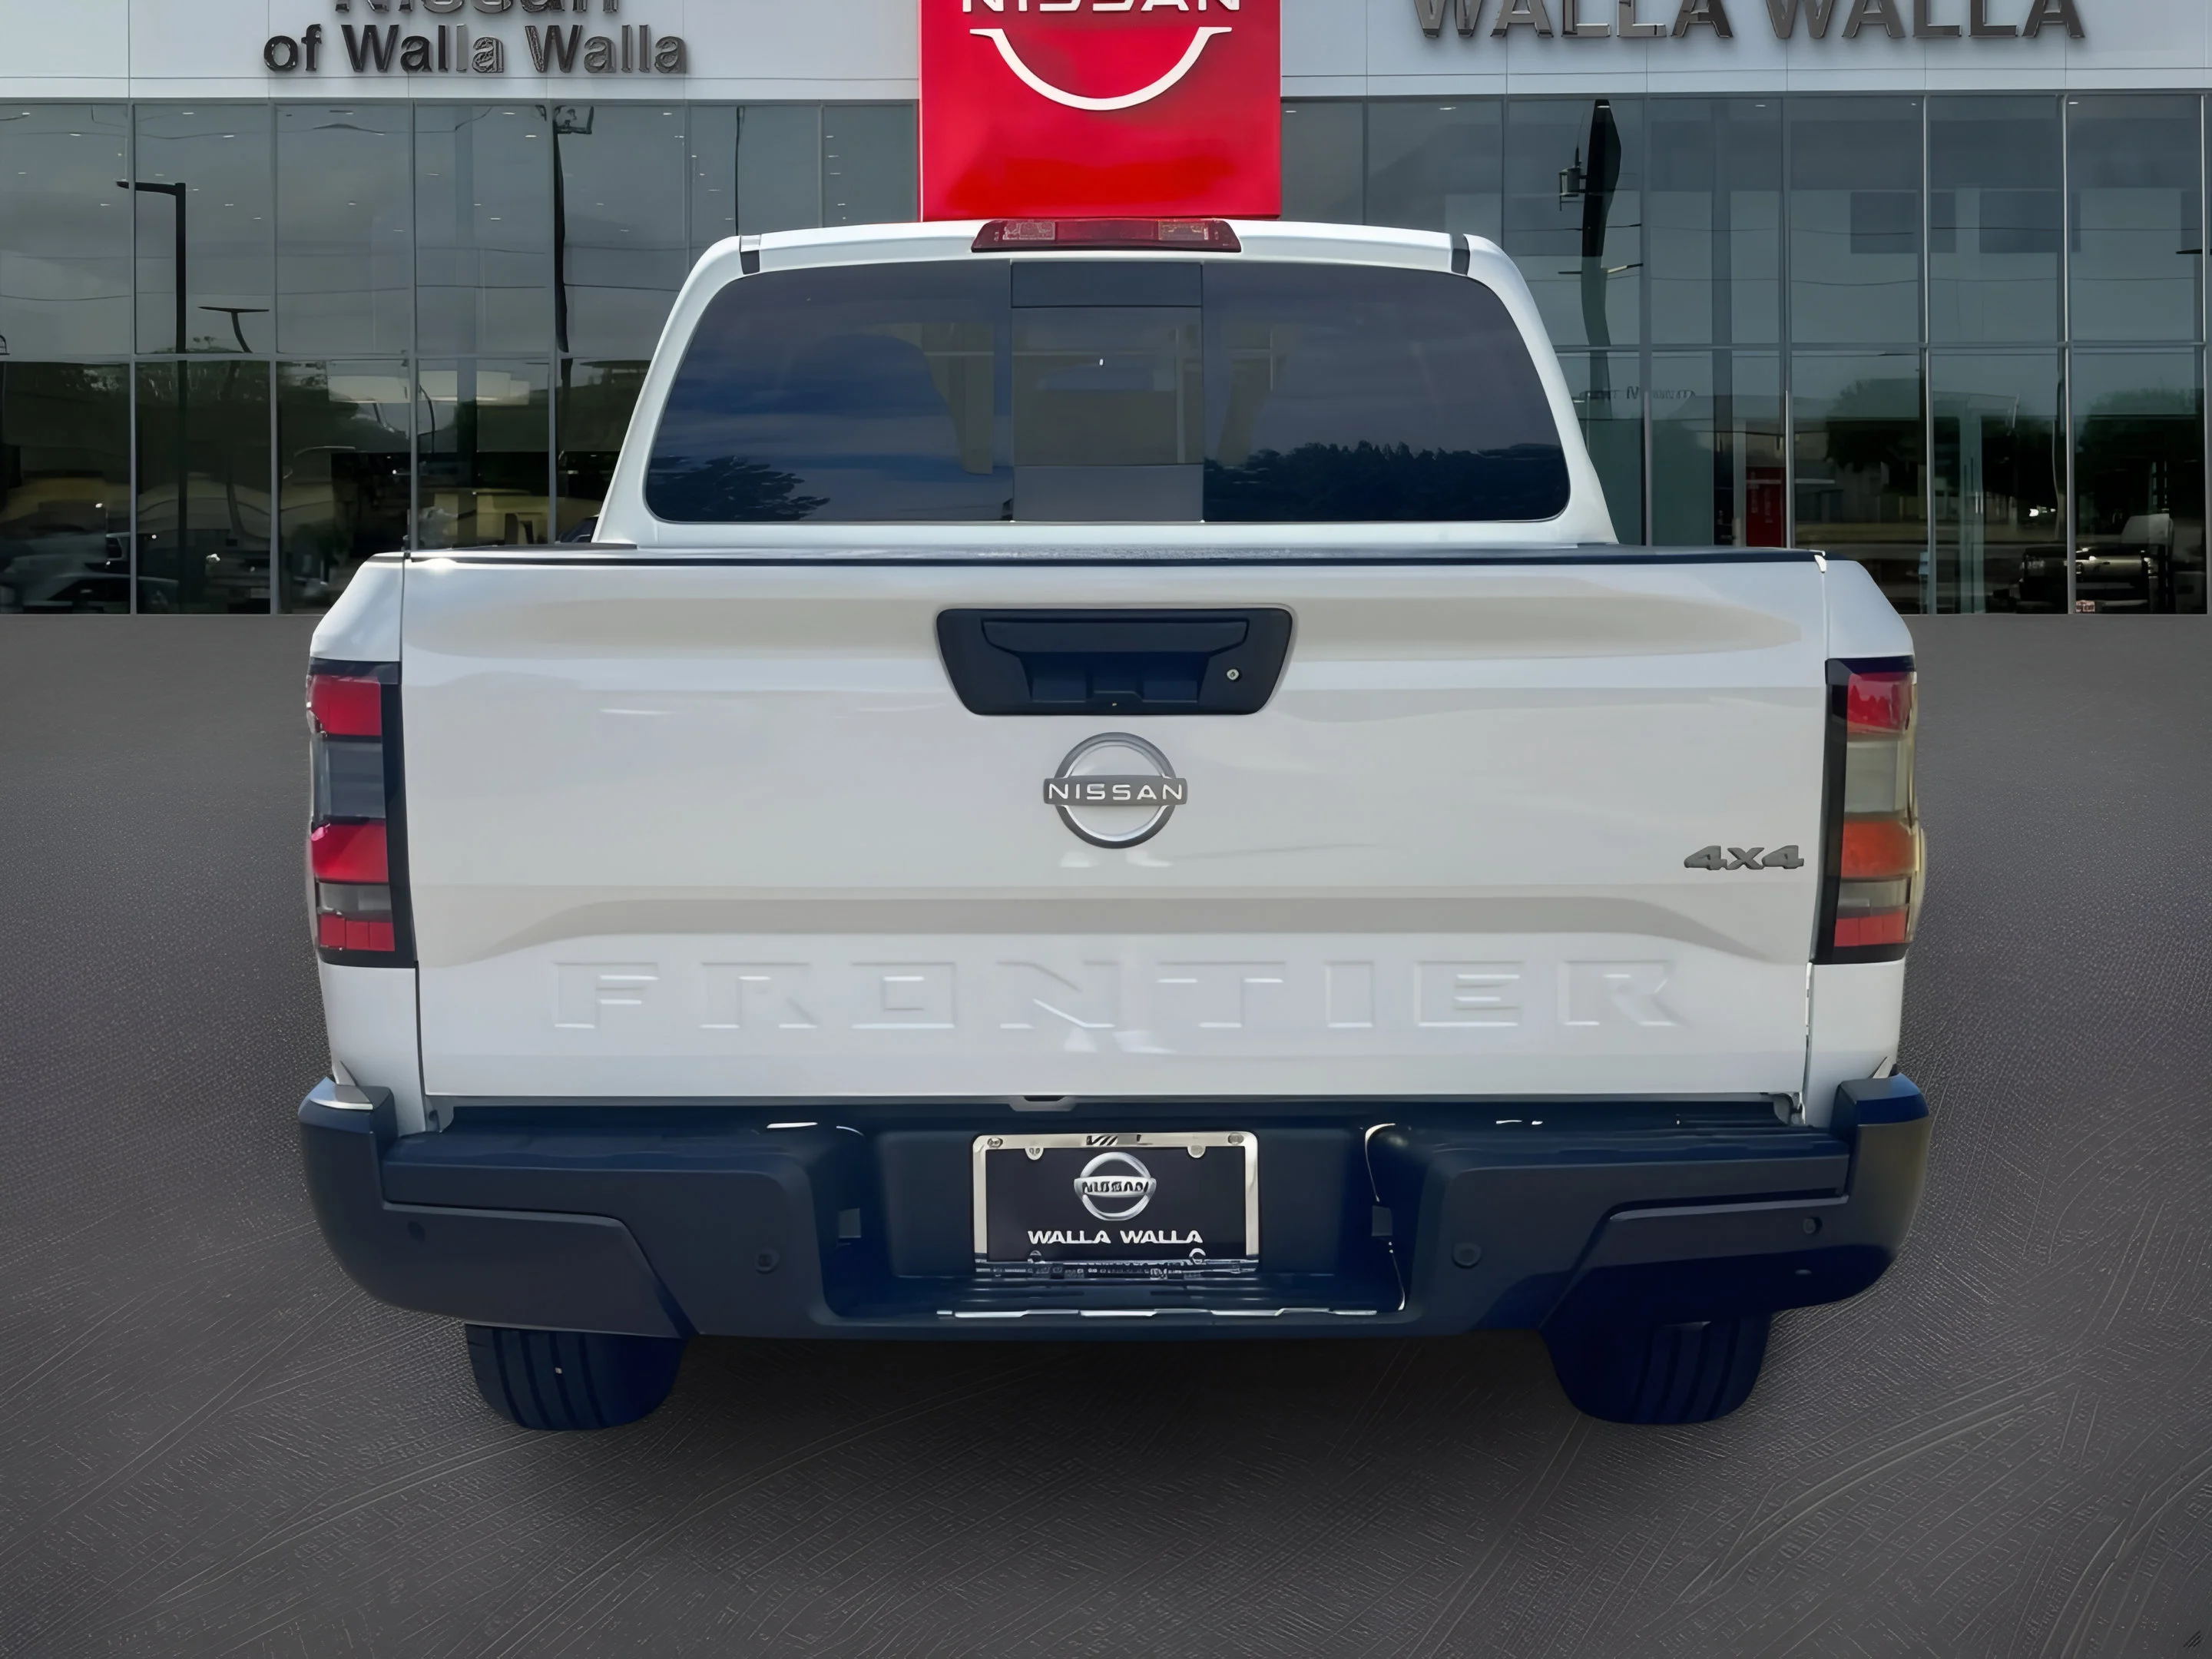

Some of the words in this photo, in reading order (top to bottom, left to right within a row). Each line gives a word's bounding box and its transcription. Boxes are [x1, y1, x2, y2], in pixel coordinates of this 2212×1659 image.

[1414, 0, 1734, 38] WALLA
[1766, 0, 2086, 39] WALLA
[263, 24, 322, 72] of
[340, 24, 505, 74] Walla
[525, 24, 687, 75] Walla
[1048, 783, 1183, 800] NISSAN
[553, 959, 1686, 1032] FRONTIER
[1028, 1230, 1111, 1244] WALLA
[1120, 1230, 1204, 1244] WALLA
